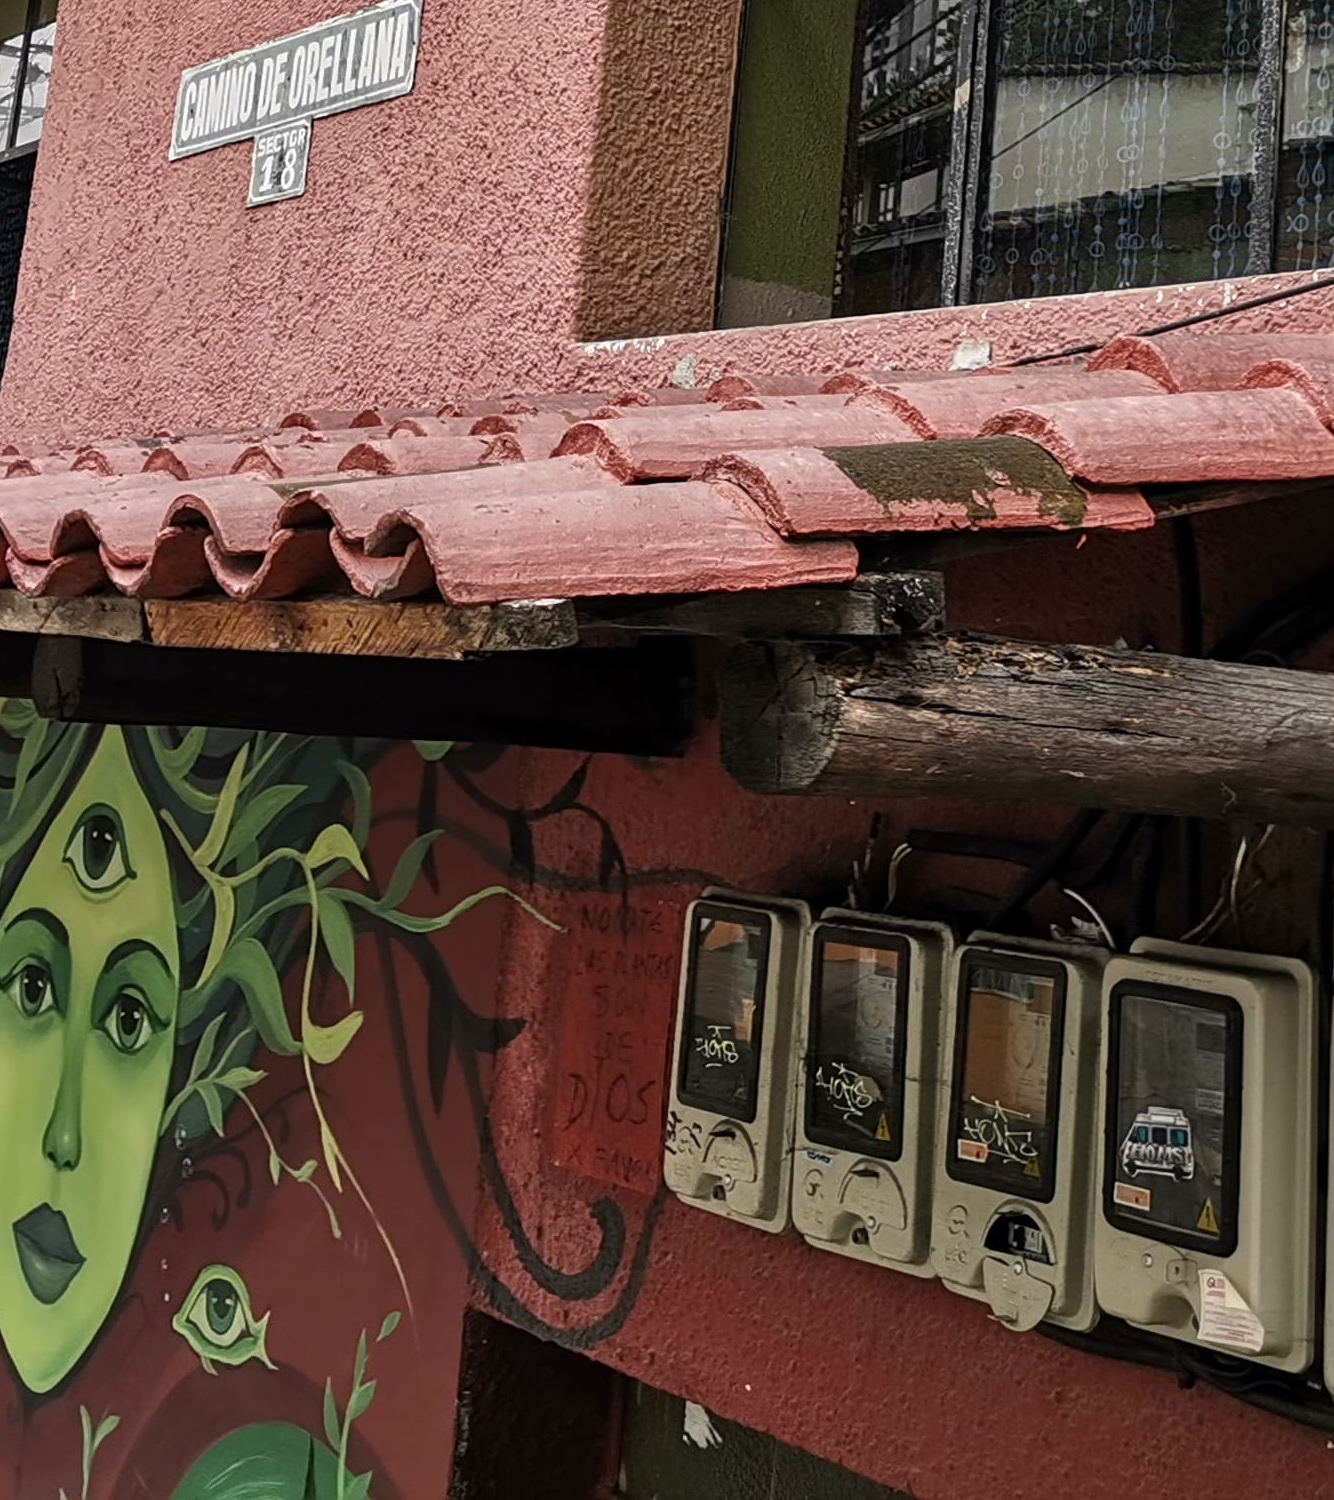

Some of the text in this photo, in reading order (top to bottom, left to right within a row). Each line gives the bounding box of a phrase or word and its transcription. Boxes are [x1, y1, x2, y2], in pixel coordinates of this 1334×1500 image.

[181, 11, 409, 142] CAMINO DE ORELLANA
[257, 129, 307, 157] SECTOR
[258, 149, 298, 192] 18
[562, 1061, 657, 1132] DIOS
